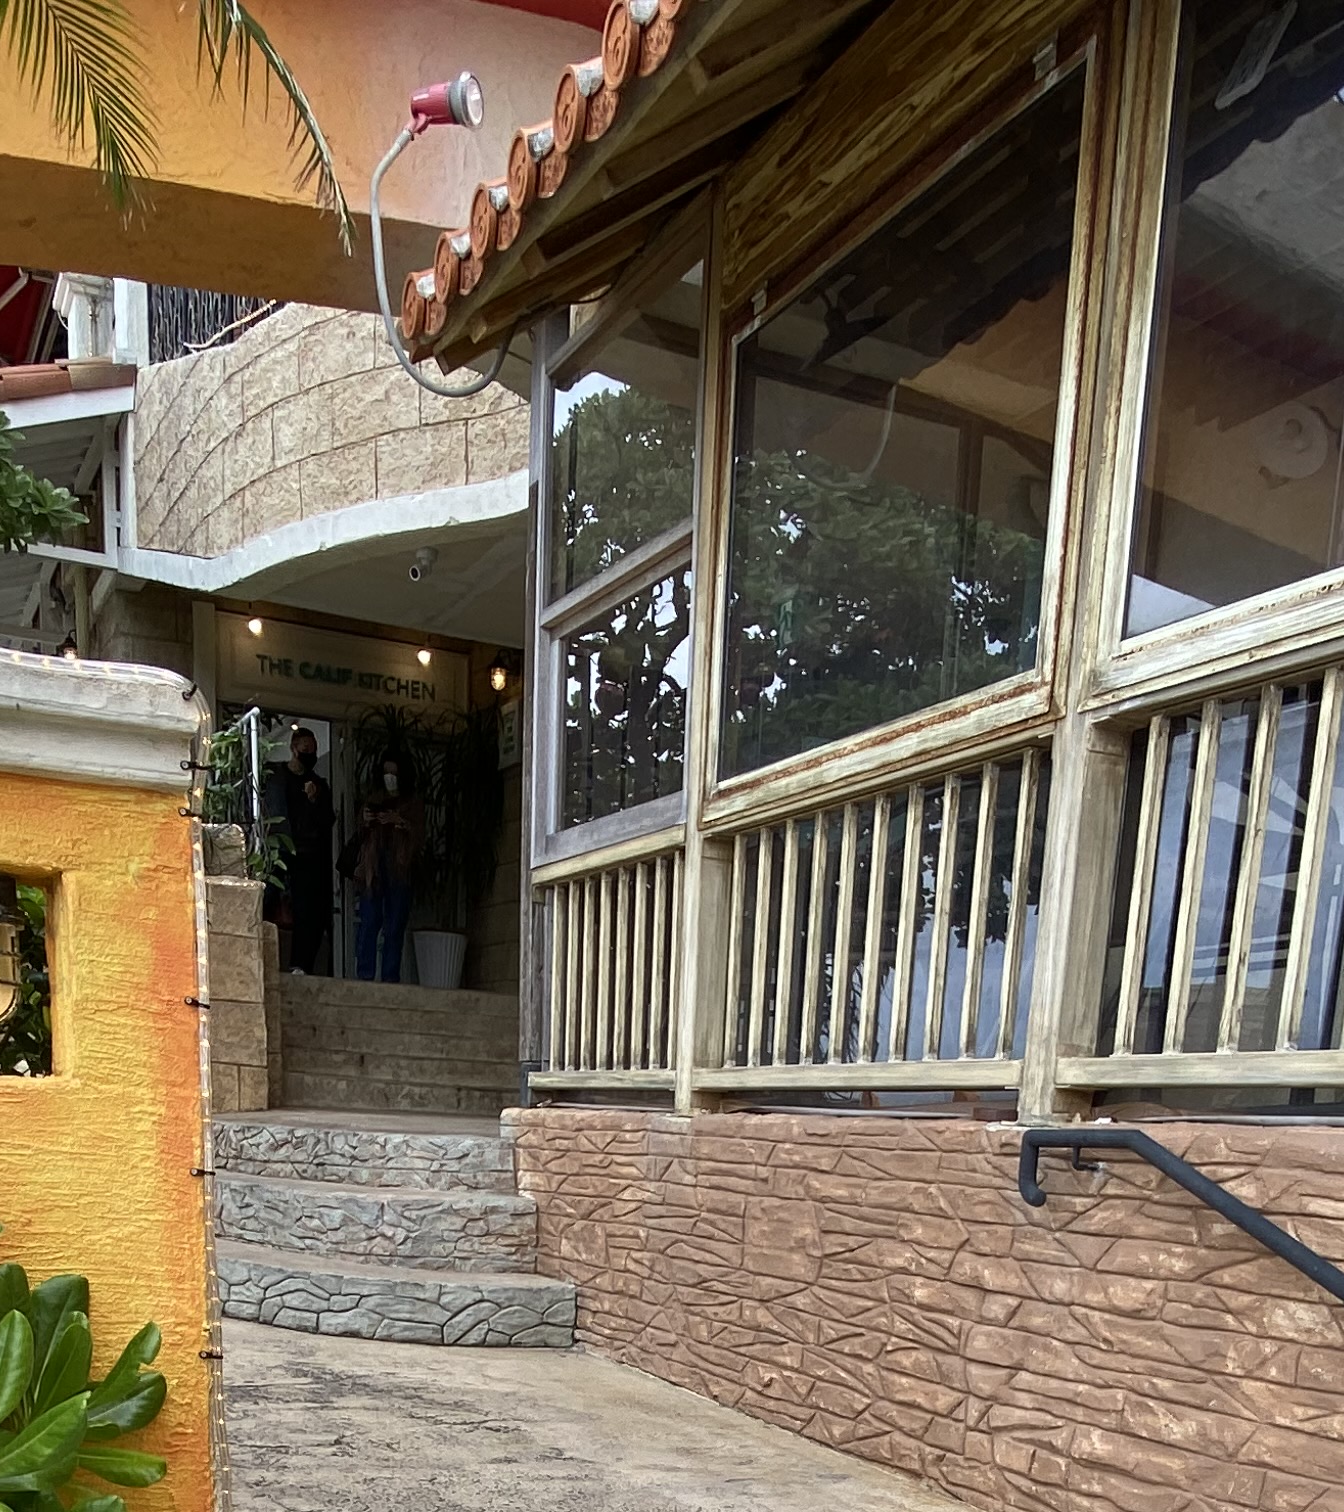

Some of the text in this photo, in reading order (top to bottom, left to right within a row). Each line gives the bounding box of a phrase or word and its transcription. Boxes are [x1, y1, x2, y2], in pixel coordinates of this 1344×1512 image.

[256, 654, 436, 701] THE CALIF KITCHEN
